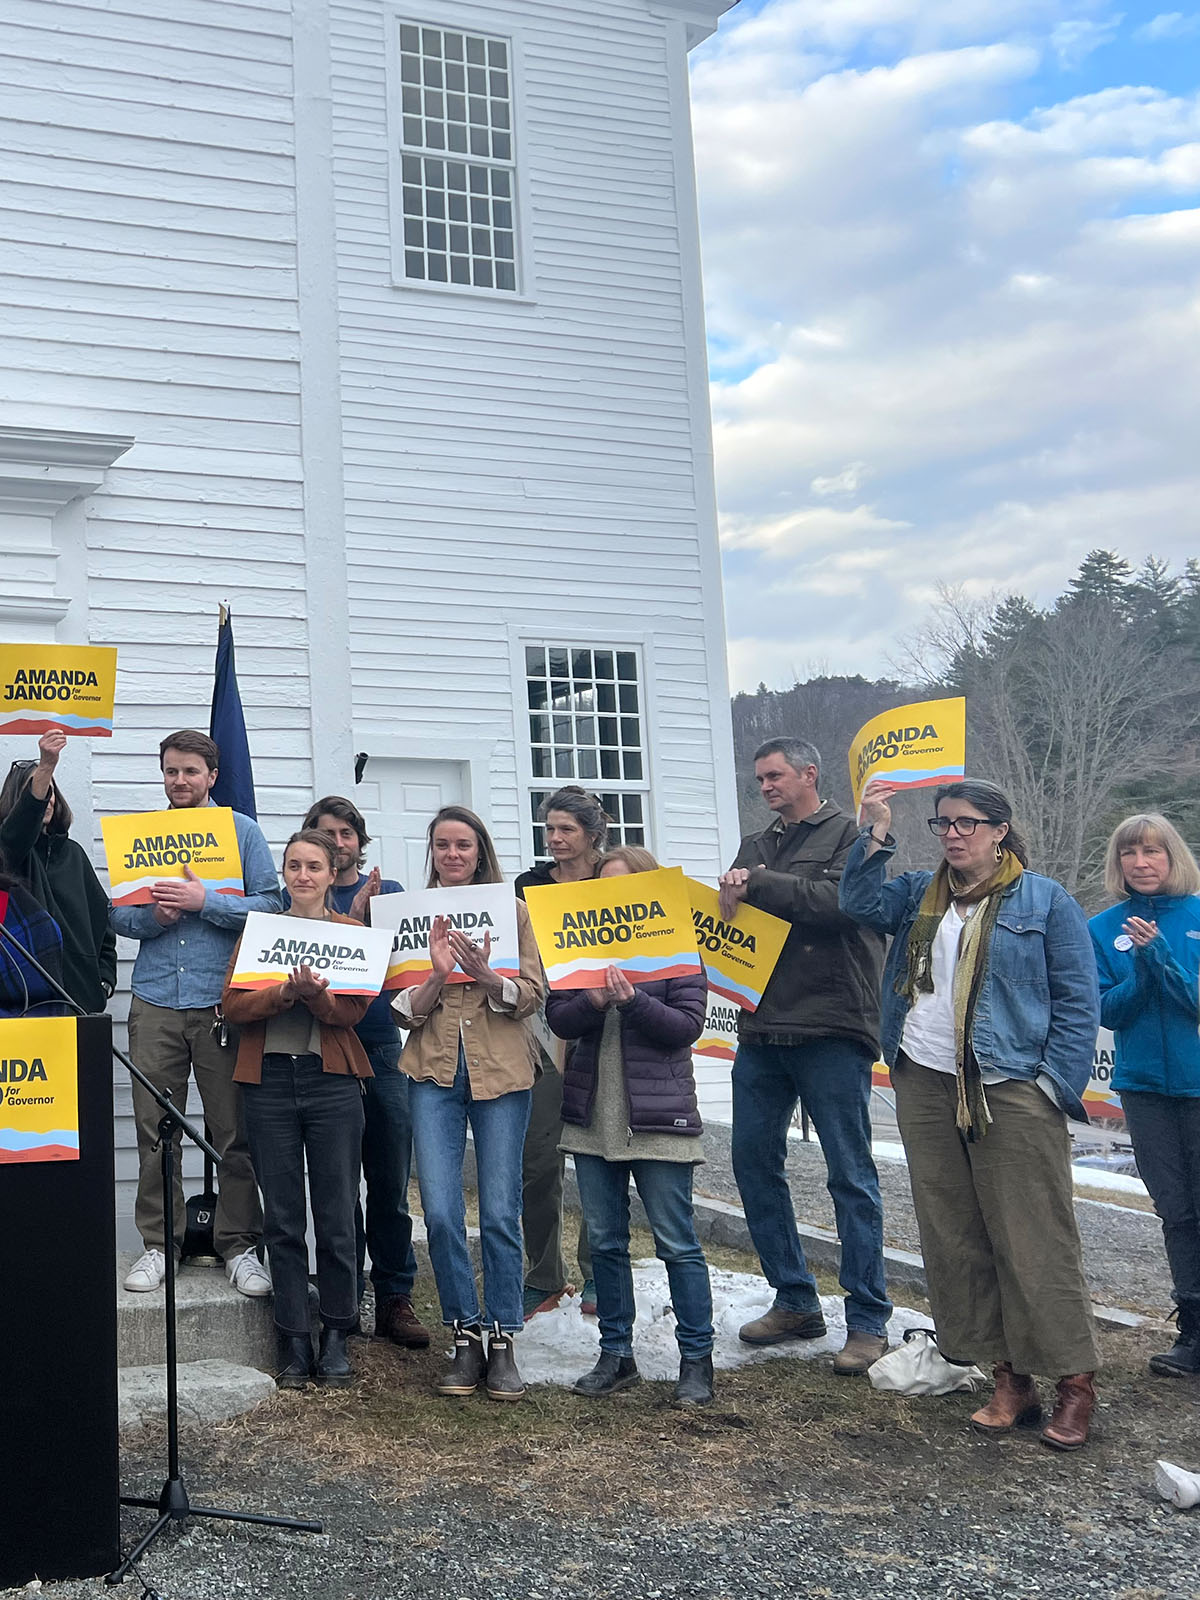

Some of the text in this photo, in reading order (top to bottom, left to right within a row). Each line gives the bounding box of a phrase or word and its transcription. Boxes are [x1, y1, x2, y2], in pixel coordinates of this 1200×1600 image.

[14, 669, 98, 687] AMANDA
[3, 685, 71, 700] JANOO
[71, 687, 82, 695] for
[73, 694, 102, 702] Governor
[902, 746, 945, 756] Governor
[132, 832, 218, 853] AMANDA
[124, 849, 192, 869] JANOO
[398, 911, 494, 935] AMNDA
[562, 900, 667, 930] AMANDA
[553, 924, 632, 949] JANOO
[632, 924, 645, 933] for
[635, 928, 675, 940] Governor
[690, 907, 756, 953] MANDA
[271, 938, 367, 961] AMANDA
[391, 932, 428, 952] JAN
[721, 942, 734, 951] for
[257, 949, 331, 969] JANOO
[332, 964, 369, 972] Governor
[721, 950, 755, 969] Governor
[5, 1086, 21, 1098] for
[7, 1096, 55, 1106] Governor
